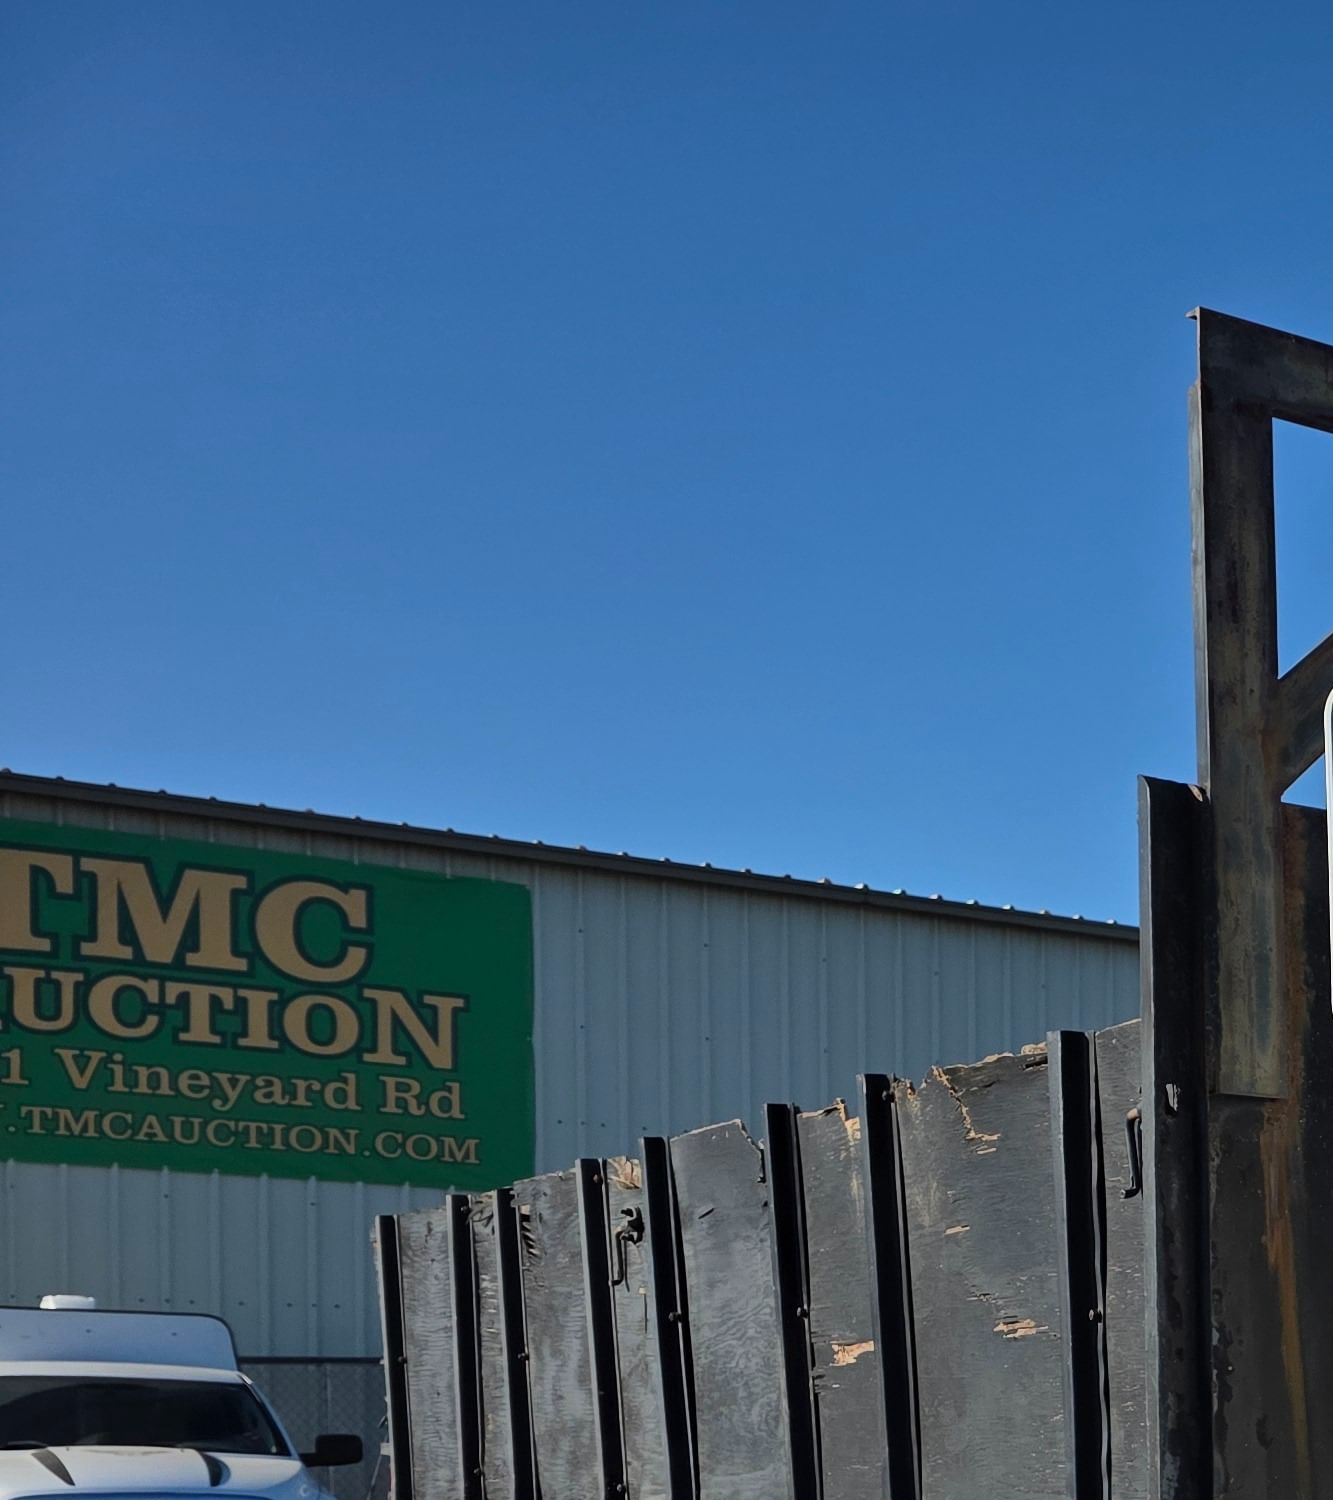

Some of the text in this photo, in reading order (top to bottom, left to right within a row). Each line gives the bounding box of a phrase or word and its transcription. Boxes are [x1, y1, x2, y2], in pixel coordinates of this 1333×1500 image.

[0, 848, 368, 984] TMC
[0, 967, 466, 1070] UCTION
[54, 1048, 361, 1111] Vineyard
[378, 1075, 466, 1120] Rd
[0, 1104, 481, 1165] .TMCAUCTION.COM
